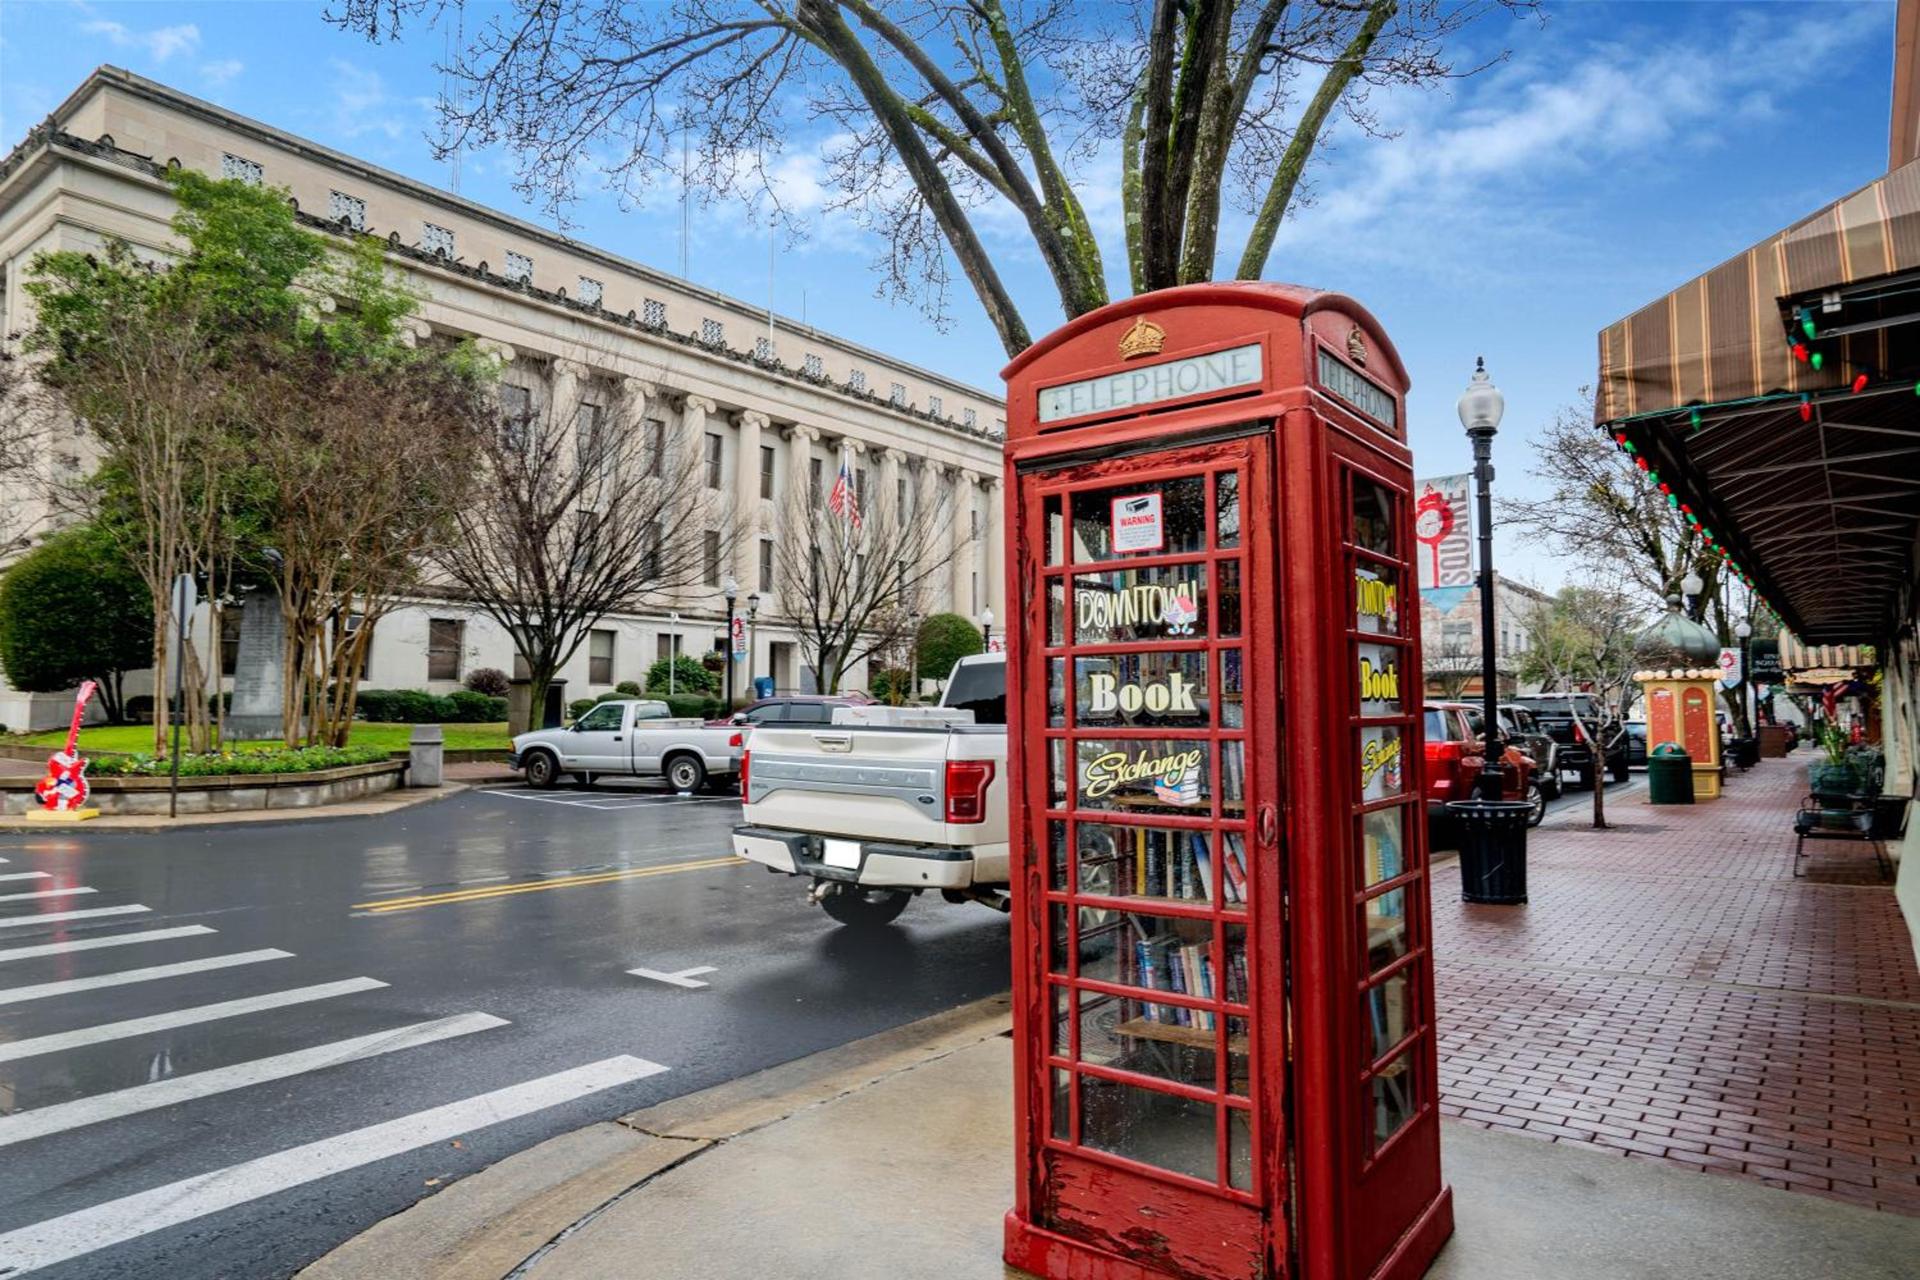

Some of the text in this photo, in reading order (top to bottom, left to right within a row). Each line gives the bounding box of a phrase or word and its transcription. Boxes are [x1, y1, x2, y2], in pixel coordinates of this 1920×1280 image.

[1051, 350, 1250, 417] TELEPHONE
[1318, 353, 1395, 425] TELEPHON
[1120, 513, 1155, 527] WARNING
[1441, 489, 1471, 585] SQUARE
[1089, 671, 1197, 713] Book
[1361, 660, 1399, 699] Book
[1086, 750, 1201, 797] Exchange
